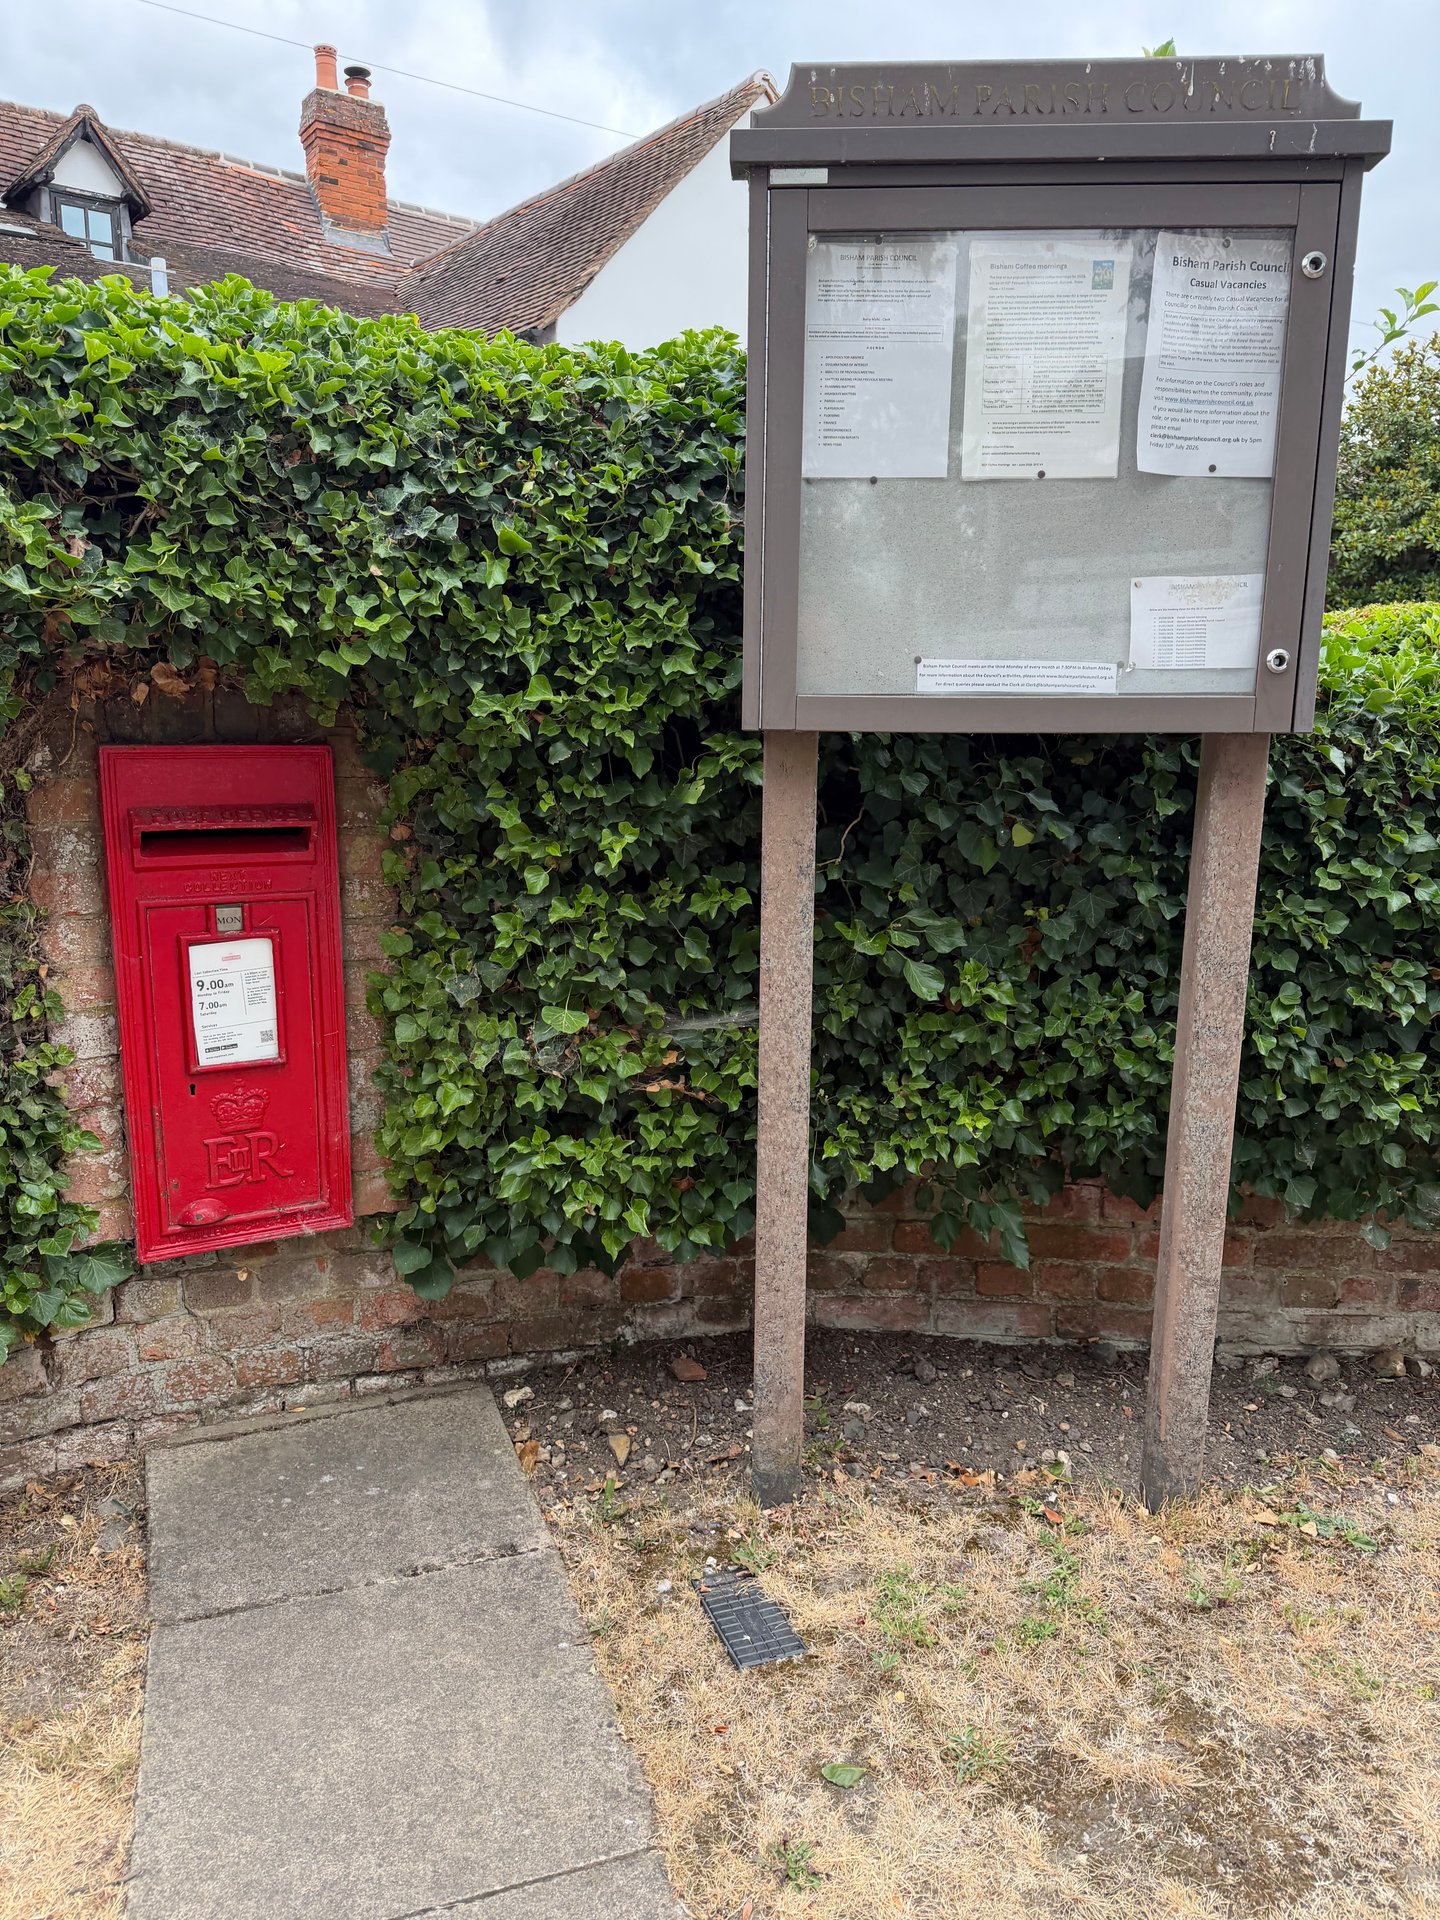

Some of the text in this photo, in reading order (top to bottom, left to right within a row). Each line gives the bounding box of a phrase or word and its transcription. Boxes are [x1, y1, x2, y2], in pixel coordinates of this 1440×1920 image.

[810, 78, 1302, 118] BISHAM PARISH COUNCIL
[1172, 256, 1290, 273] Bisham Parish Council
[1190, 278, 1267, 290] Casual Vacancies
[1155, 386, 1192, 394] responsibilities
[209, 870, 248, 882] NEXT
[184, 879, 272, 893] COLLECTION
[216, 916, 242, 925] MON
